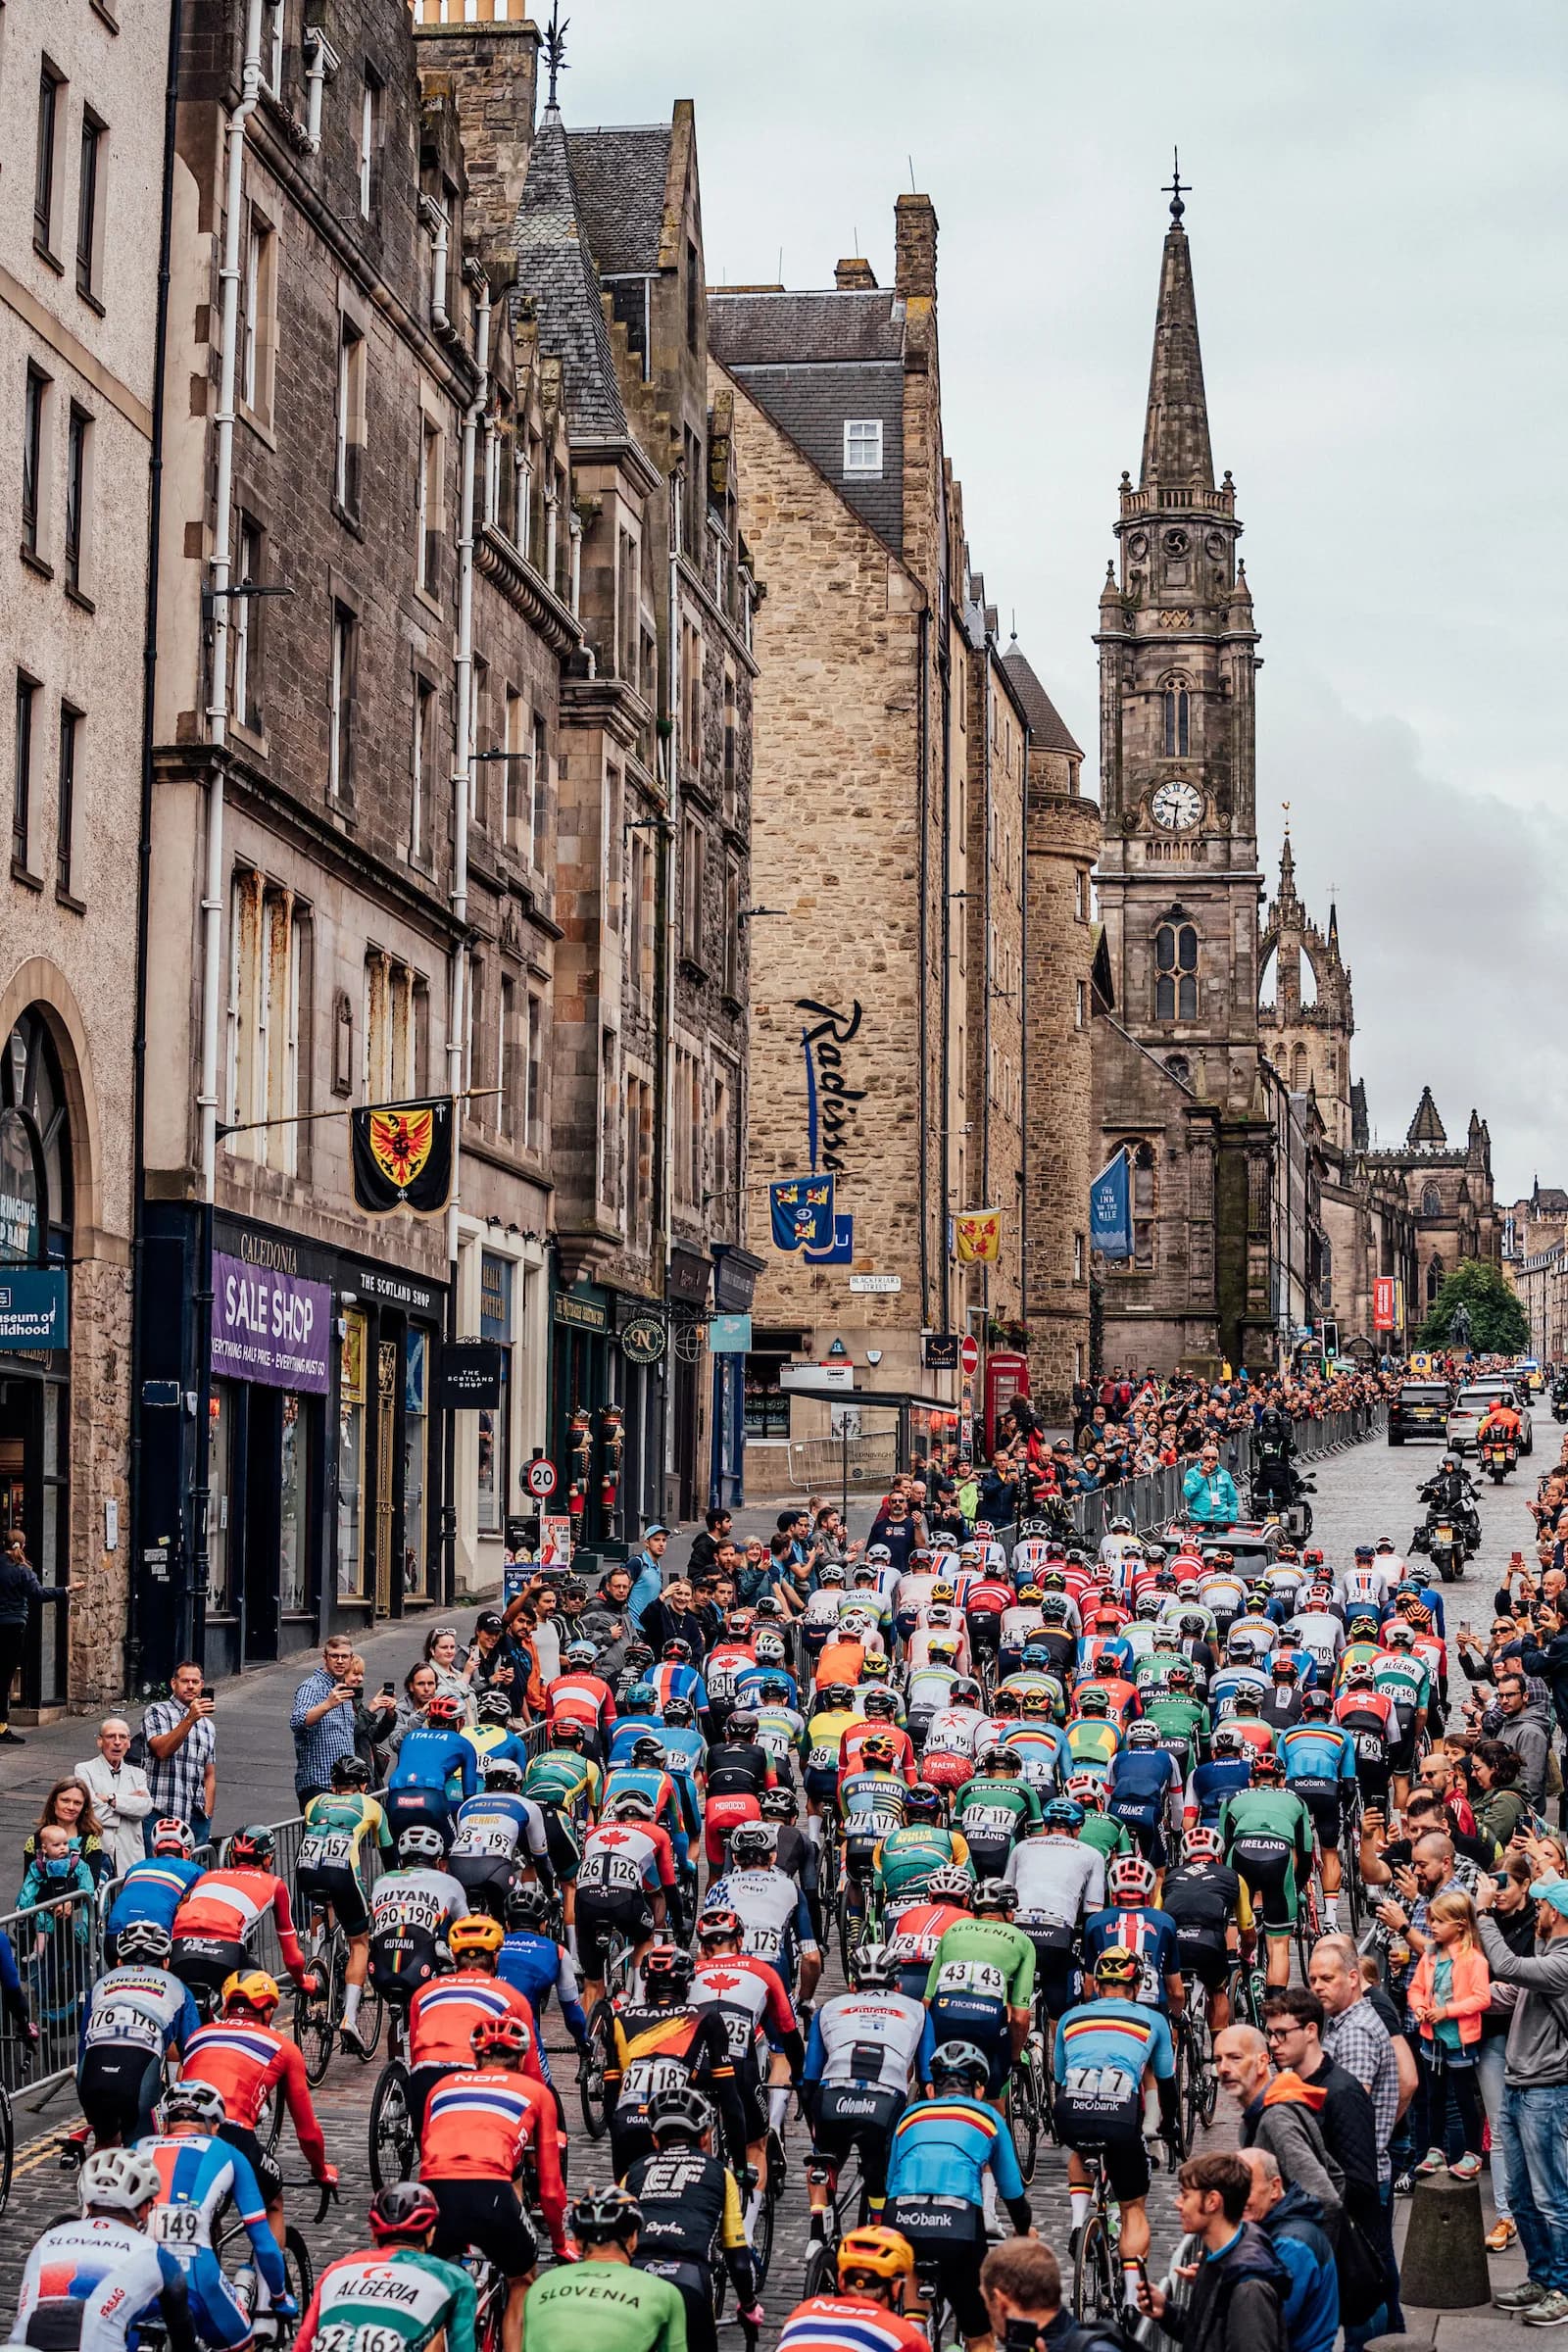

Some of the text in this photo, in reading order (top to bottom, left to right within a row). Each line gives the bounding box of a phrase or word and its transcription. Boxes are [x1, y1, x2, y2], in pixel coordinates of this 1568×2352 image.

[795, 999, 867, 1170] Radisso
[1100, 1195, 1114, 1203] INN
[1099, 1210, 1117, 1219] MILE
[240, 1234, 298, 1274] CALEDONIA
[361, 1273, 430, 1308] THE SCOTLAND SHOP
[225, 1275, 314, 1344] SALE SHOP
[211, 1337, 242, 1360] VERYTHING
[242, 1348, 257, 1362] HALF
[274, 1353, 306, 1372] EVERYTHING
[532, 1470, 553, 1486] 20
[1317, 1648, 1333, 1660] 105
[1383, 1662, 1416, 1676] ALGERIA
[709, 1678, 723, 1693] 124
[1141, 1689, 1171, 1698] IRELAN
[411, 1733, 449, 1741] ITALIA
[771, 1739, 783, 1750] 71
[1365, 1740, 1378, 1753] 90
[671, 1753, 687, 1764] 175
[1038, 1764, 1045, 1776] 2
[858, 1783, 903, 1798] RWANDA
[971, 1785, 1019, 1794] IRELAND
[1236, 1787, 1297, 1795] IRELAND
[714, 1801, 746, 1810] MOROCCO
[1117, 1803, 1146, 1816] FRANCE
[967, 1807, 1011, 1824] 117 117
[966, 1830, 1005, 1841] IRELAND
[327, 1838, 349, 1857] 157
[1241, 1839, 1286, 1850] IRELAND
[211, 1869, 263, 1879] AUSTRIA
[579, 1860, 636, 1882] 126 126
[375, 1889, 440, 1911] GUYANA
[376, 1906, 433, 1930] 190 190
[951, 1925, 1016, 1944] SLOVENIA
[1104, 1922, 1157, 1936] USA
[383, 1938, 415, 1950] GUYANA
[754, 1931, 778, 1952] 173
[102, 1976, 168, 1988] VENEZUELA
[944, 1964, 1002, 1987] 43 43
[624, 2005, 699, 2018] UGANDA
[132, 2009, 157, 2033] 176
[727, 2020, 747, 2045] 25
[454, 2074, 509, 2082] NOR
[623, 2068, 687, 2091] 87 187
[1077, 2068, 1123, 2092] 7 7
[836, 2096, 876, 2114] Colombia
[639, 2190, 682, 2201] Education
[161, 2212, 197, 2242] 149
[48, 2236, 131, 2252] SLOVAKIA
[335, 2278, 420, 2305] ALGERIA
[538, 2284, 642, 2310] SLOVENIA
[810, 2300, 880, 2317] NOR
